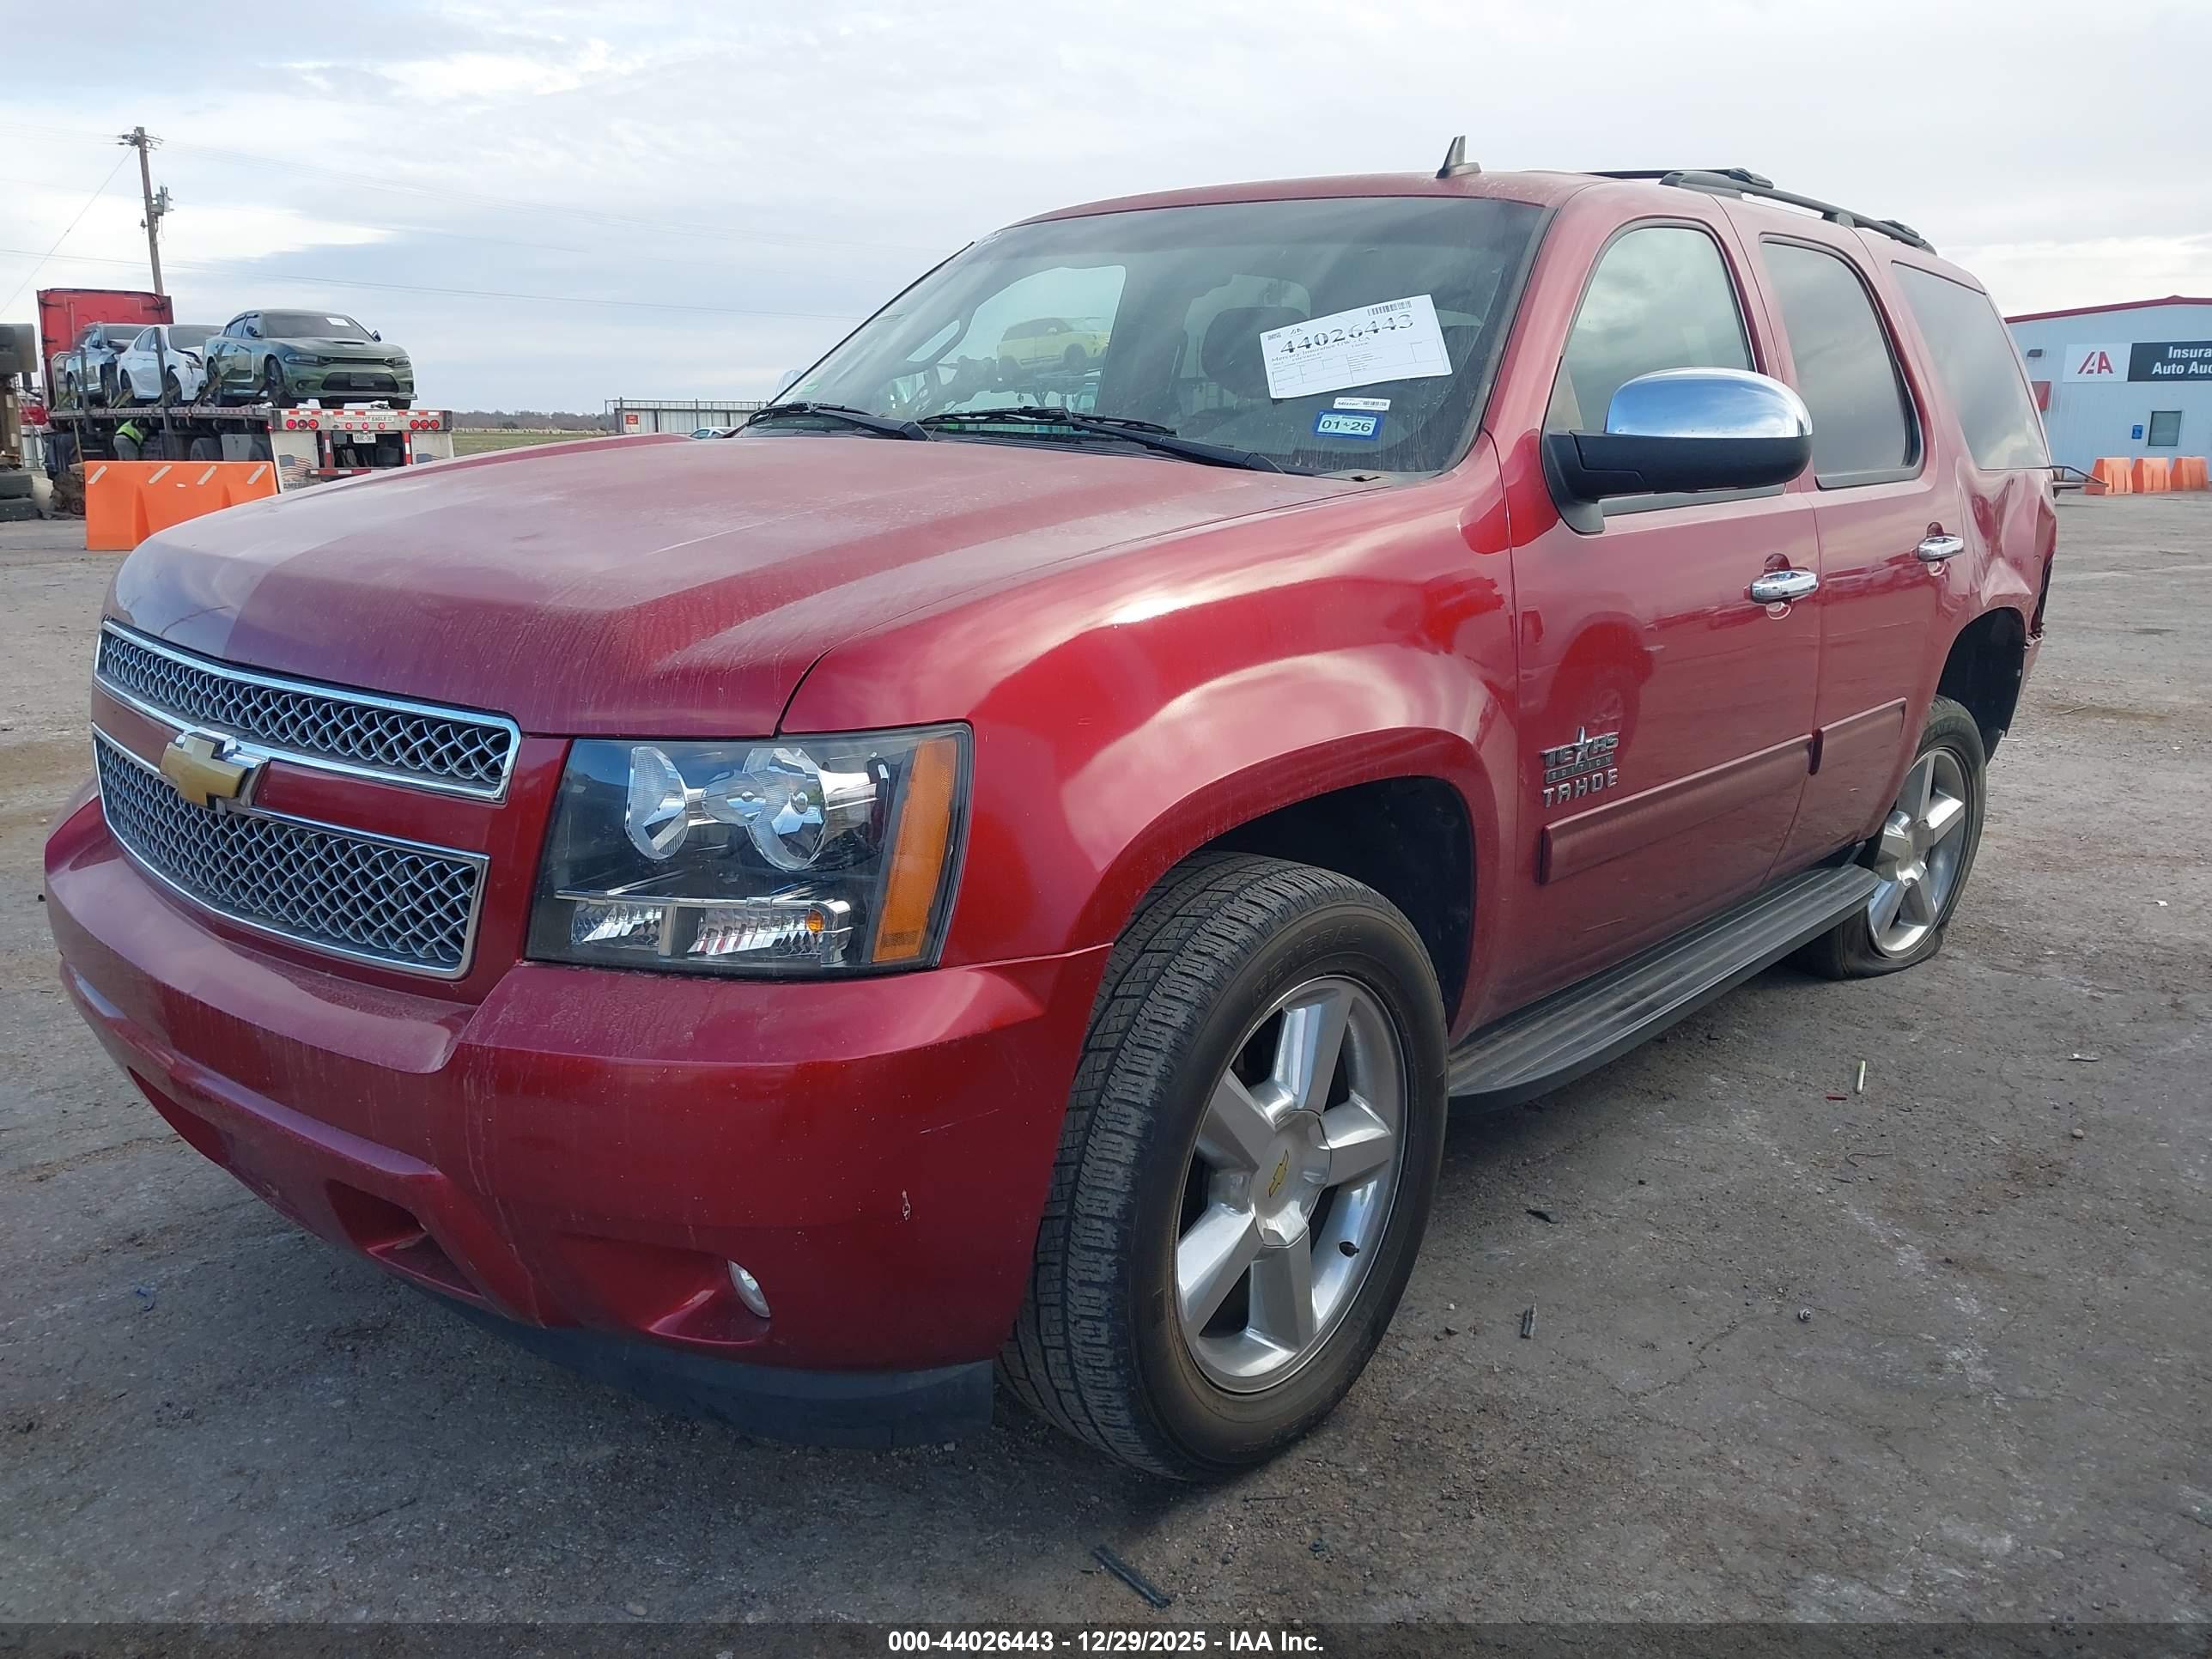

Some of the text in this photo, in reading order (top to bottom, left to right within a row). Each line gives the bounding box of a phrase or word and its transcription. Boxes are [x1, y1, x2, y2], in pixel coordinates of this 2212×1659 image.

[1280, 314, 1413, 353] 44026443
[2152, 362, 2184, 375] Auto
[1322, 419, 1372, 432] 01 26
[1540, 730, 1620, 767] TEXAS
[1542, 768, 1619, 809] TAHOE
